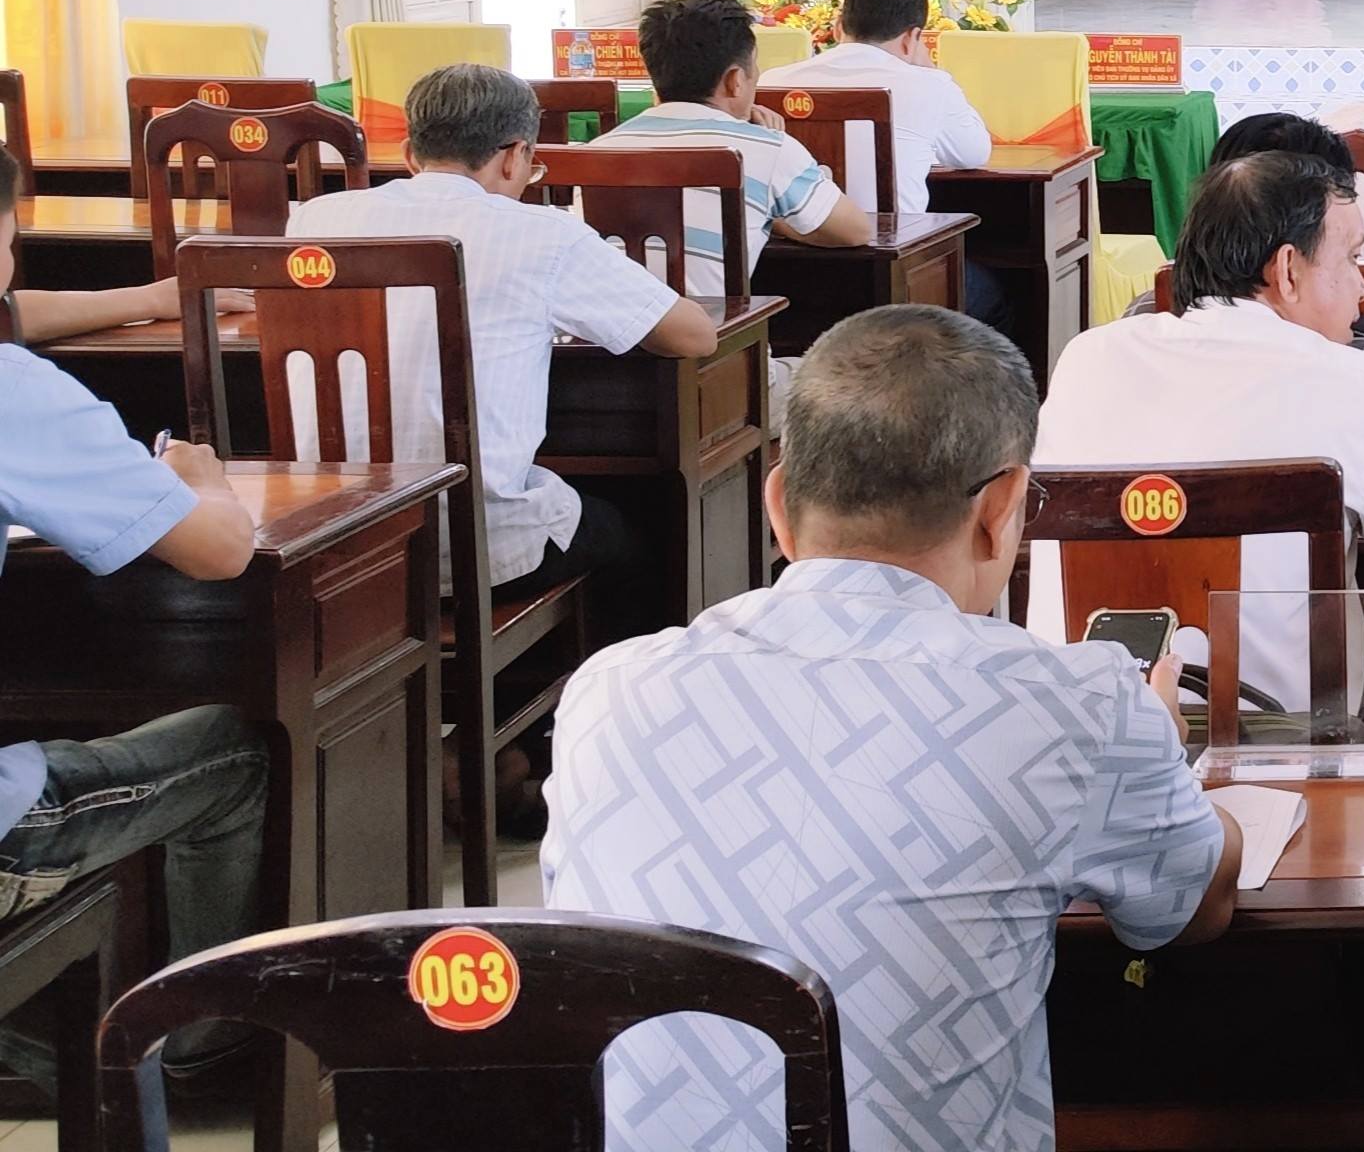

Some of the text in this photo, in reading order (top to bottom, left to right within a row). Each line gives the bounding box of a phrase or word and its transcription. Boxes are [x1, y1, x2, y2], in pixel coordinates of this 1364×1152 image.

[596, 41, 623, 59] CHIẾN
[1088, 45, 1176, 64] GUYỄN THÀNH TÀI
[202, 88, 225, 104] 011
[784, 98, 810, 113] 046
[234, 125, 265, 144] 034
[290, 256, 331, 279] 044
[1125, 488, 1180, 521] 086
[419, 950, 508, 1008] 063
